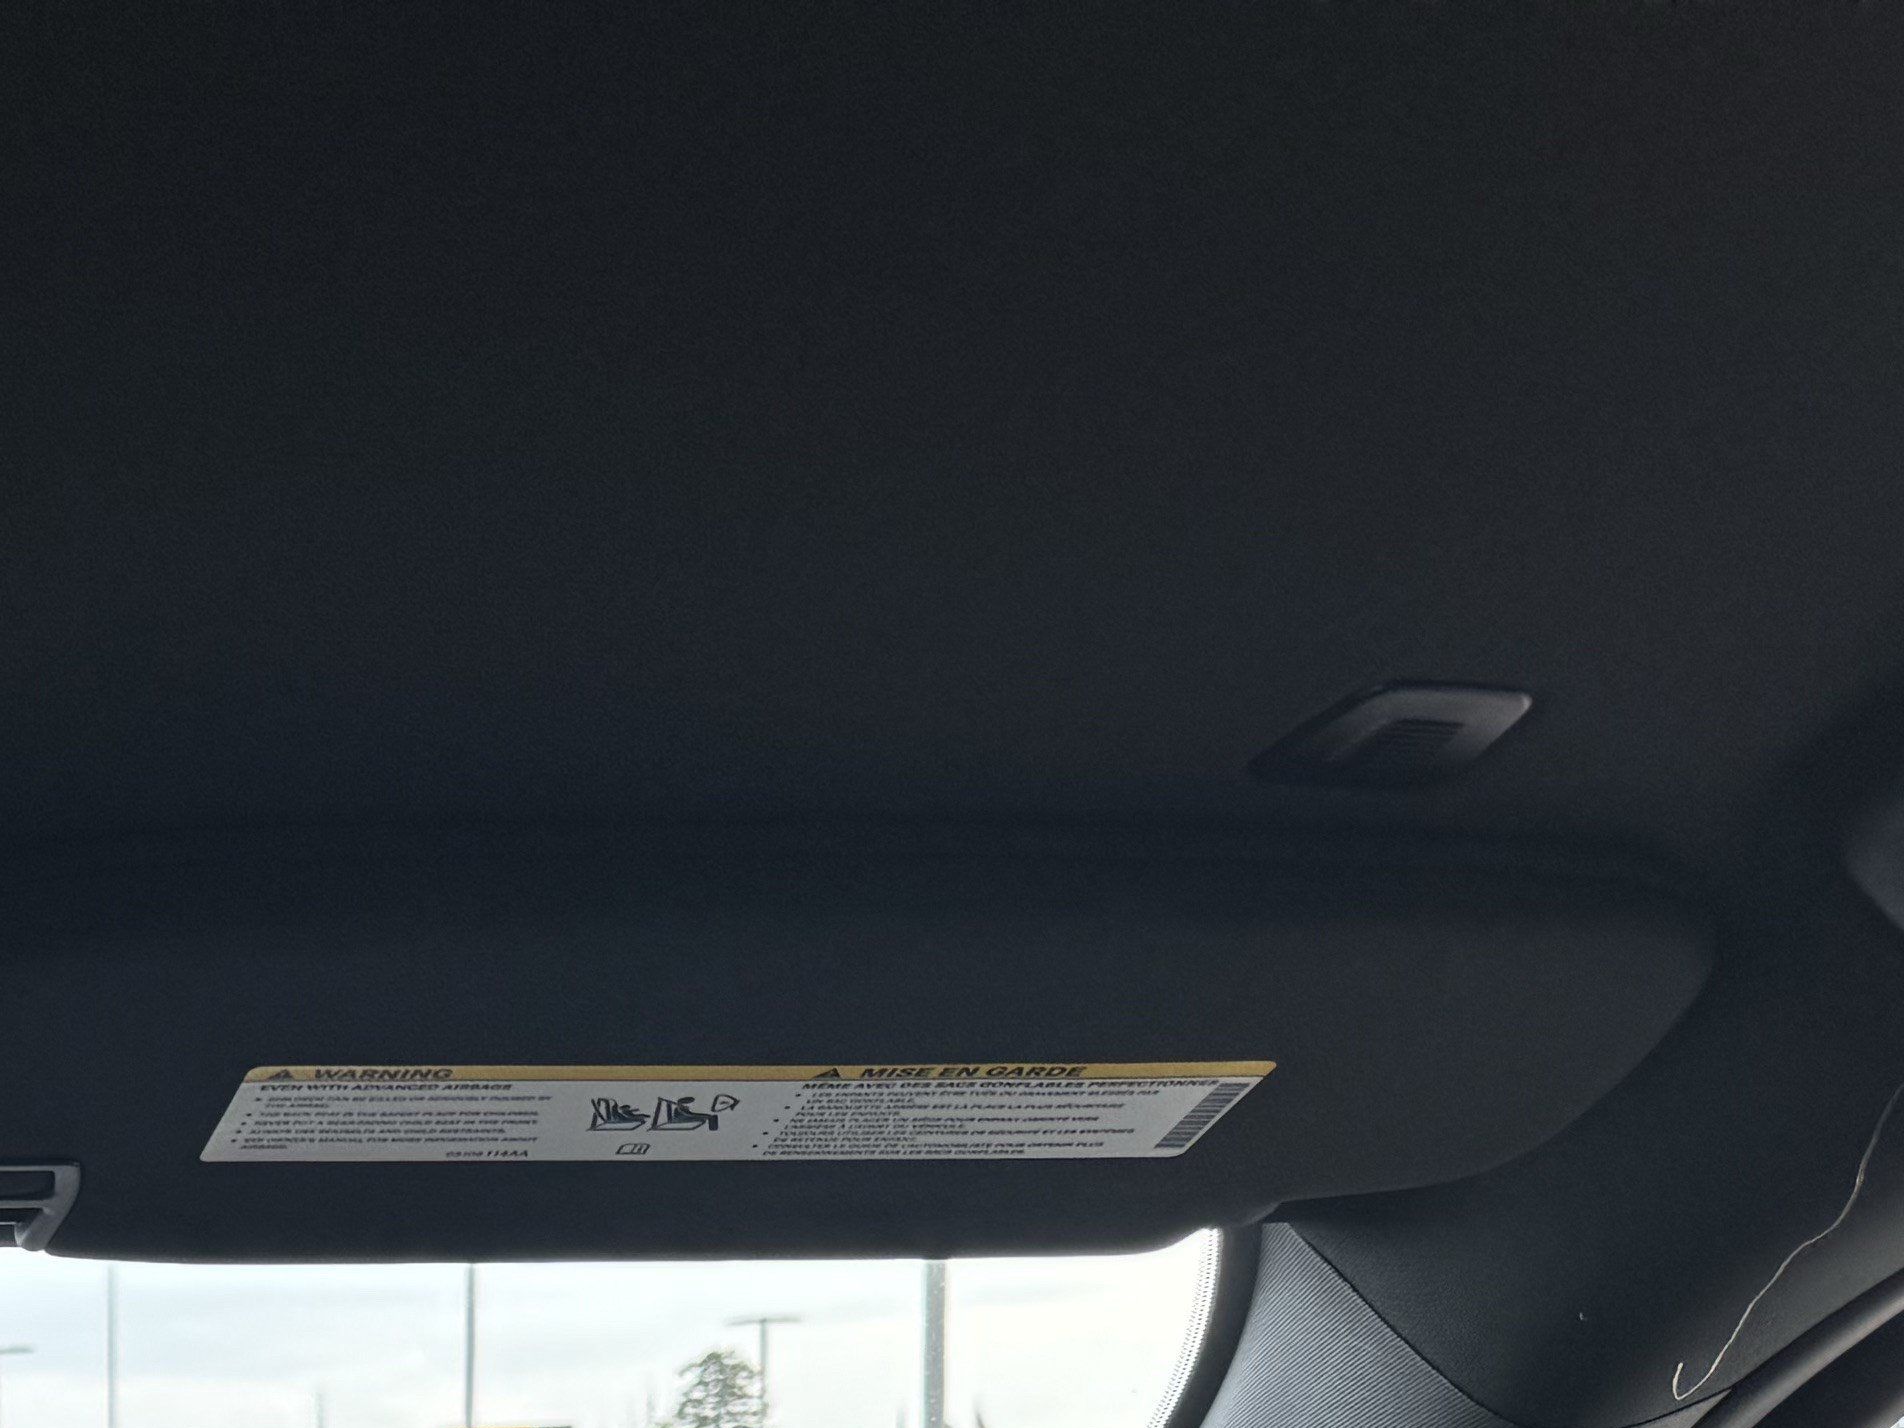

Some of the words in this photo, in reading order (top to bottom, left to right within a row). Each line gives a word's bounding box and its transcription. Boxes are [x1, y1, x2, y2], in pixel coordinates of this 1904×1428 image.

[315, 1068, 453, 1079] WARNING
[861, 1067, 935, 1078] MISE
[939, 1067, 981, 1077] EN
[986, 1066, 1087, 1077] GARDE
